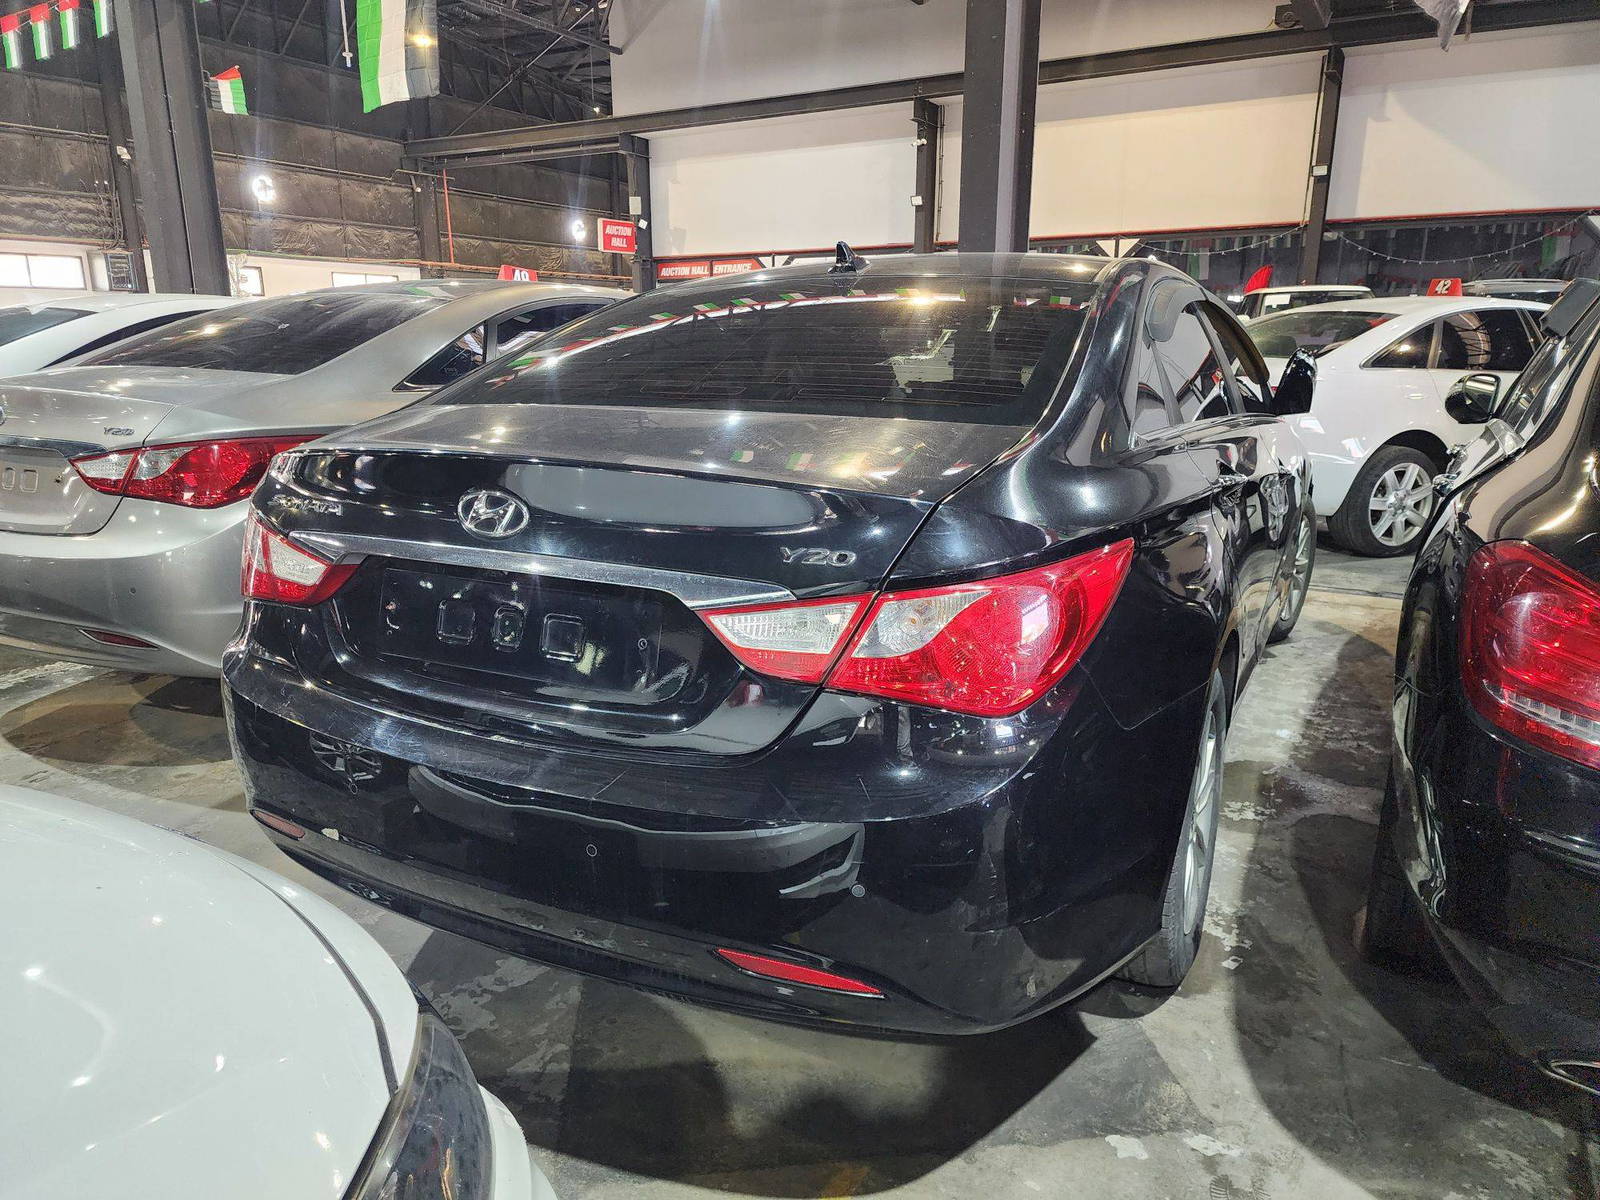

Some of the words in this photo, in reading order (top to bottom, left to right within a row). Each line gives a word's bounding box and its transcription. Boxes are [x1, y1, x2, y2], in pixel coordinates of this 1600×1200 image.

[605, 224, 632, 237] AUCTION
[611, 238, 628, 248] HALL
[660, 266, 690, 277] AUCTION
[691, 265, 710, 275] HALL
[713, 263, 752, 274] ENTRANCE
[1434, 279, 1452, 294] 42
[779, 546, 857, 567] Y20
